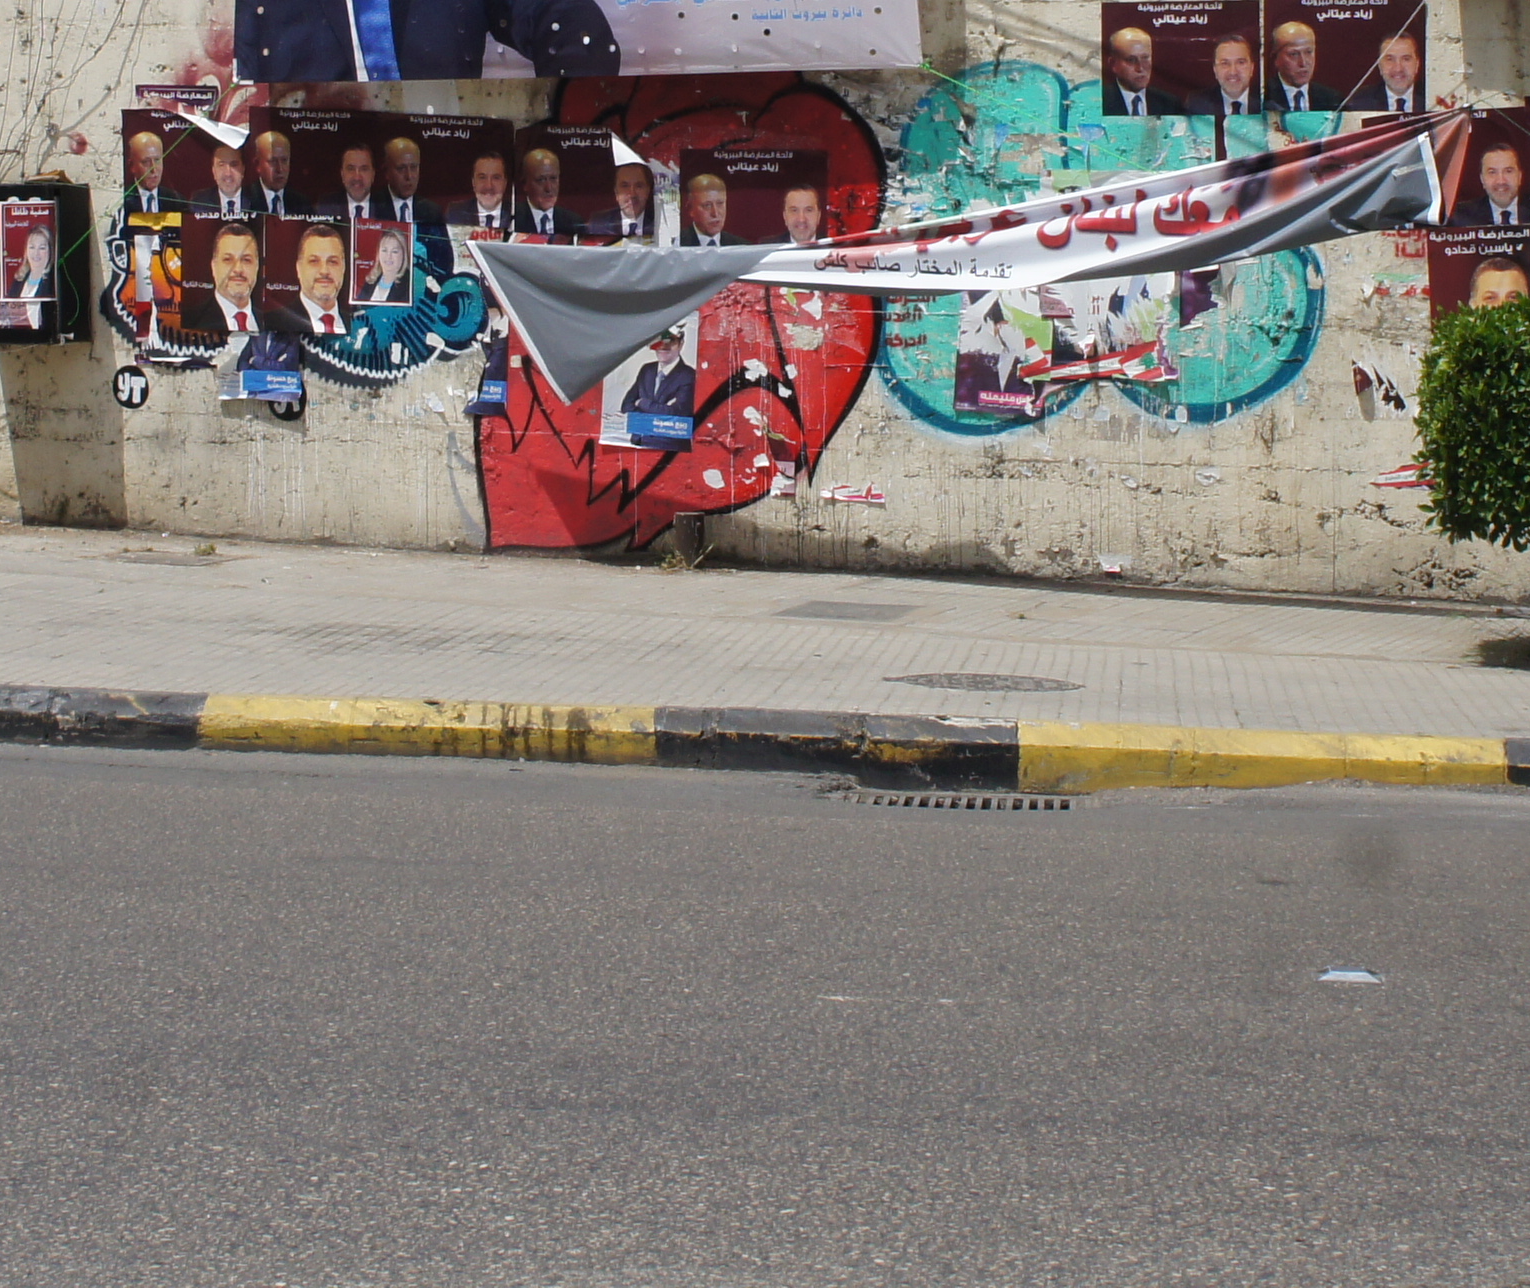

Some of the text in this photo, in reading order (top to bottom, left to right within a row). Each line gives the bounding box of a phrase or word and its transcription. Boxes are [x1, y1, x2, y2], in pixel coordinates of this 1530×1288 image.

[1137, 3, 1170, 13] البيروتية
[1171, 2, 1204, 12] المعارضة
[1152, 13, 1208, 27] زياد عيتاني
[1316, 8, 1373, 22] زياد عيتاني
[291, 121, 338, 133] زياد عيتاني
[422, 128, 470, 140] زياد عيتاني
[561, 137, 611, 149] زياد عيتاني
[713, 150, 743, 160] البيروتية
[743, 150, 775, 160] المعارضة
[726, 162, 779, 174] زياد عيتاني
[29, 206, 50, 218] صفية
[1036, 188, 1147, 252] لبنان
[1429, 228, 1530, 243] المعارضة البيروتية
[1444, 243, 1513, 257] ياسين قدادو
[855, 252, 901, 274] صائب
[909, 255, 962, 280] المختار
[968, 262, 1013, 281] تقدمة
[979, 391, 1017, 405] منيمنه
